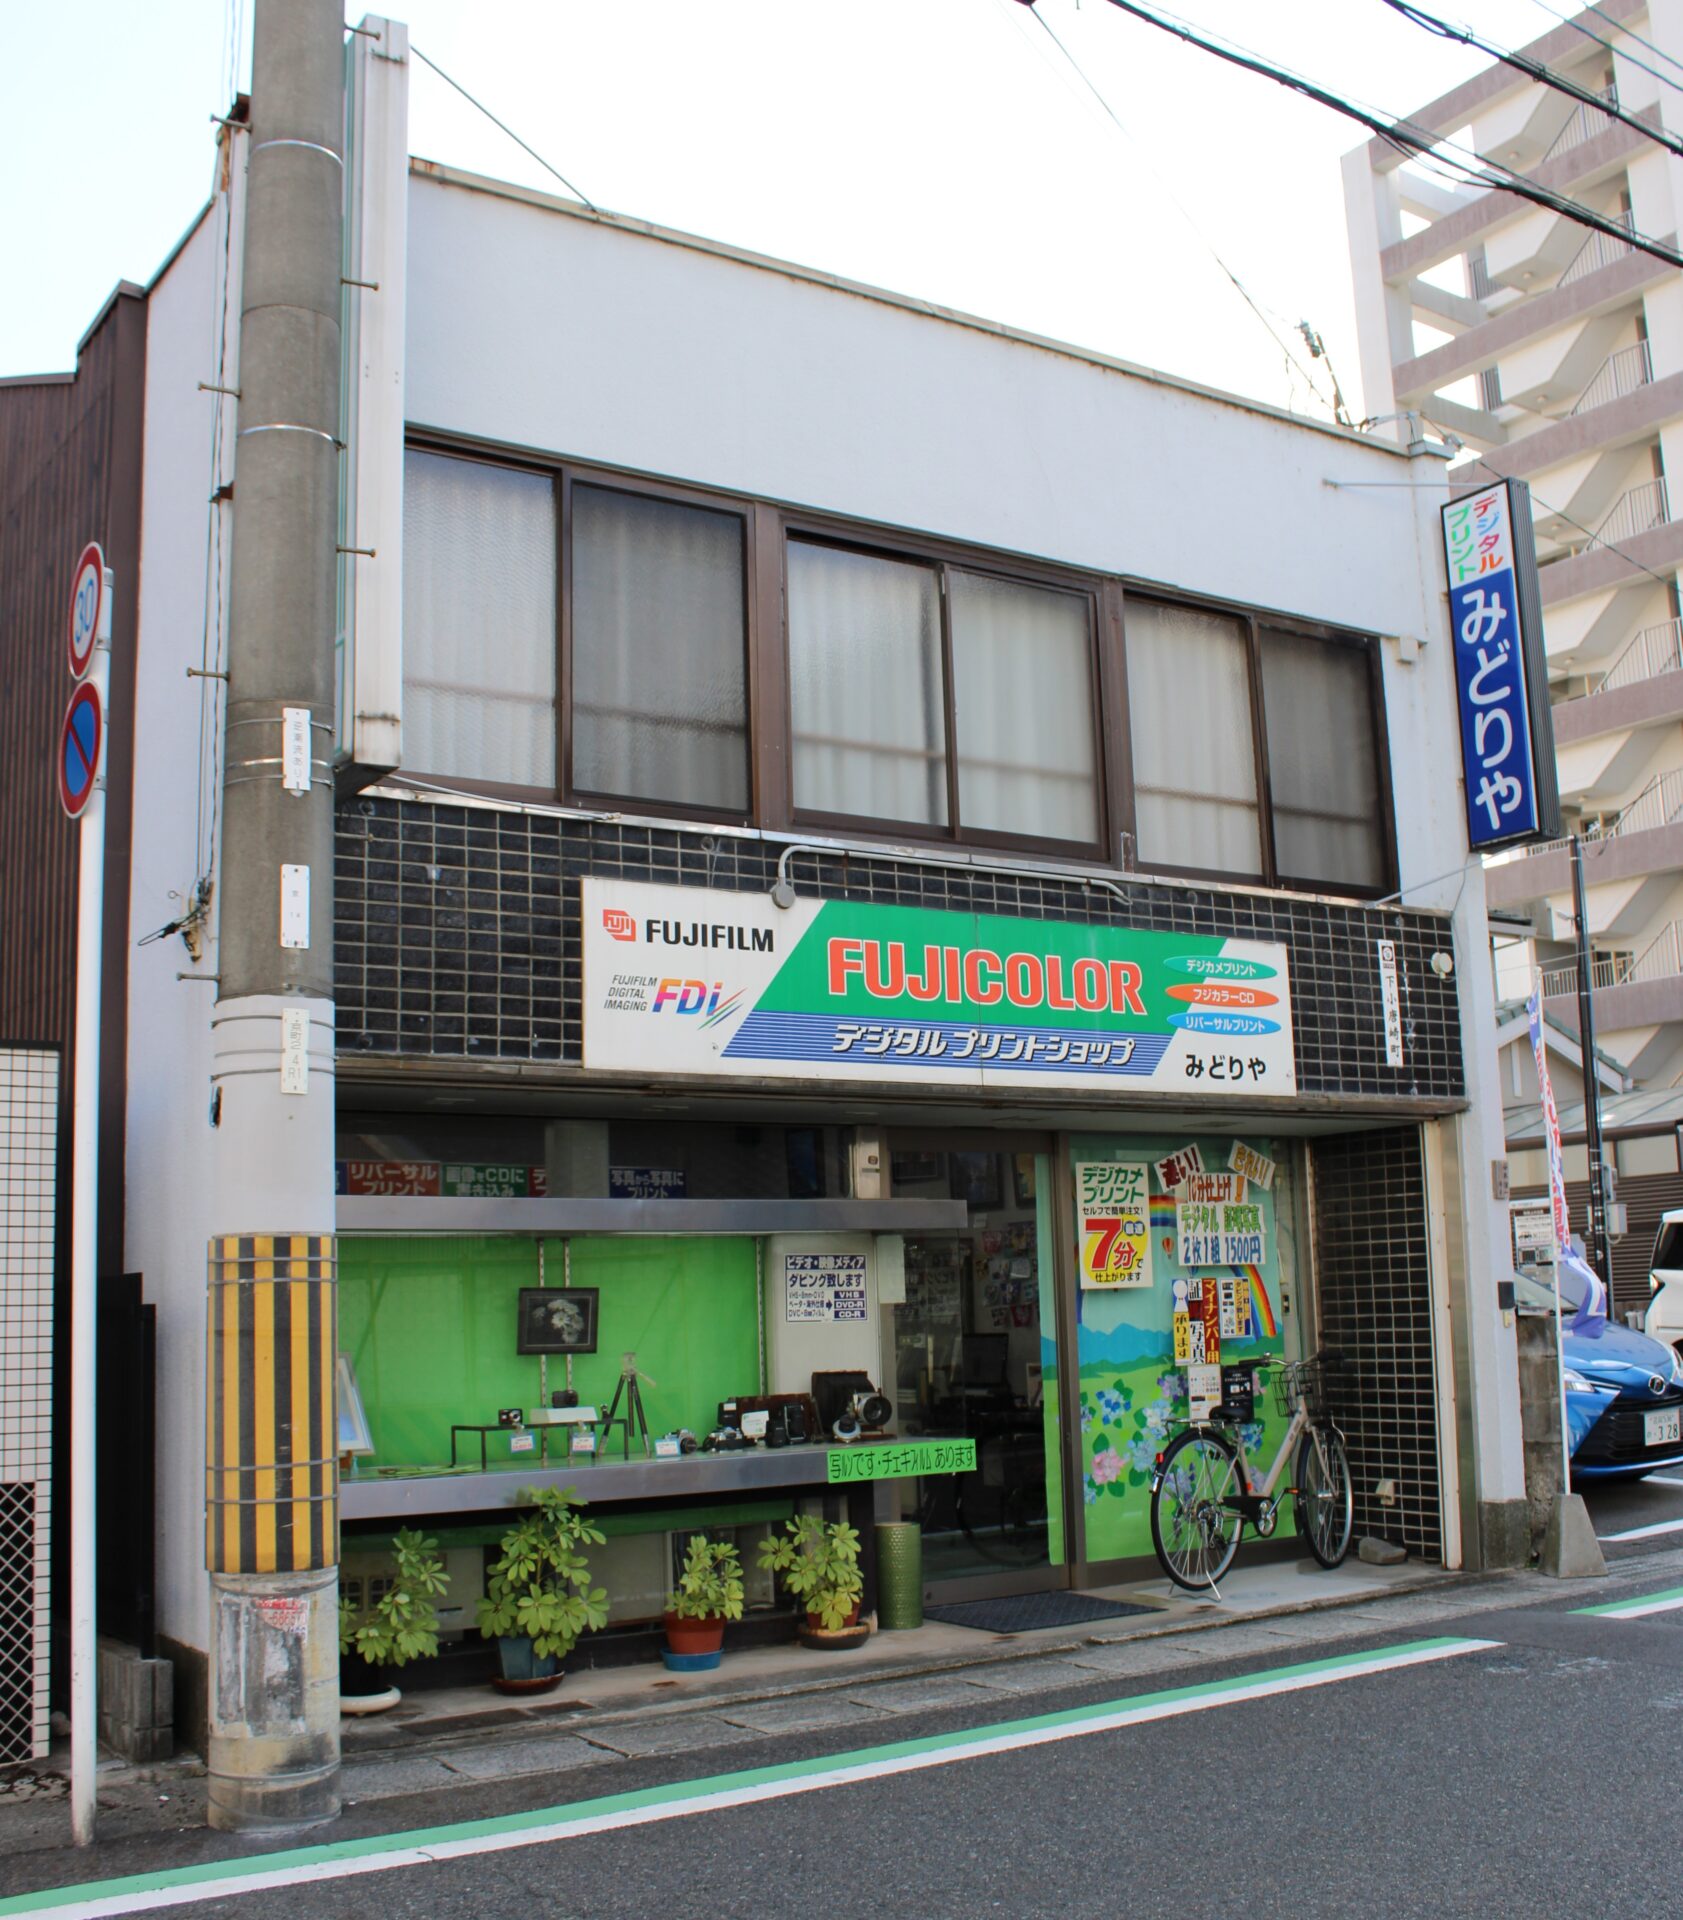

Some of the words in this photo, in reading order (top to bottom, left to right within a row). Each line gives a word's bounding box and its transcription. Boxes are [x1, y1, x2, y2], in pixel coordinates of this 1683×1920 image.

[1447, 504, 1476, 582] プリント
[1473, 492, 1504, 574] デジタル
[75, 578, 95, 644] 30
[1461, 589, 1522, 830] みどりや
[646, 919, 774, 952] FUJIFILM
[828, 937, 1147, 1015] FUJICOLOR
[1186, 959, 1257, 977] デジカメプリント
[612, 974, 657, 987] FUJIFILM
[608, 987, 645, 999] DIGITAL
[652, 978, 724, 1017] FDi
[1192, 988, 1255, 1004] フジカラーCD
[604, 1000, 647, 1012] IMAGING
[1185, 1016, 1265, 1033] リバーサルプリント
[832, 1024, 948, 1057] デジタル
[951, 1030, 1137, 1066] プリントショップ
[1185, 1054, 1266, 1081] みどりや
[351, 1163, 437, 1180] リバーサル
[1083, 1166, 1144, 1185] デジカメ
[362, 1181, 426, 1196] プリント
[627, 1186, 669, 1199] プリント
[1083, 1186, 1144, 1204] プリント
[1181, 1205, 1219, 1233] デジタル
[1226, 1235, 1261, 1264] 1500円
[789, 1273, 863, 1288] ダビング致します
[1095, 1272, 1141, 1283] 仕上がります
[1203, 1279, 1219, 1363] マイナンバー用
[935, 1445, 974, 1469] あります
